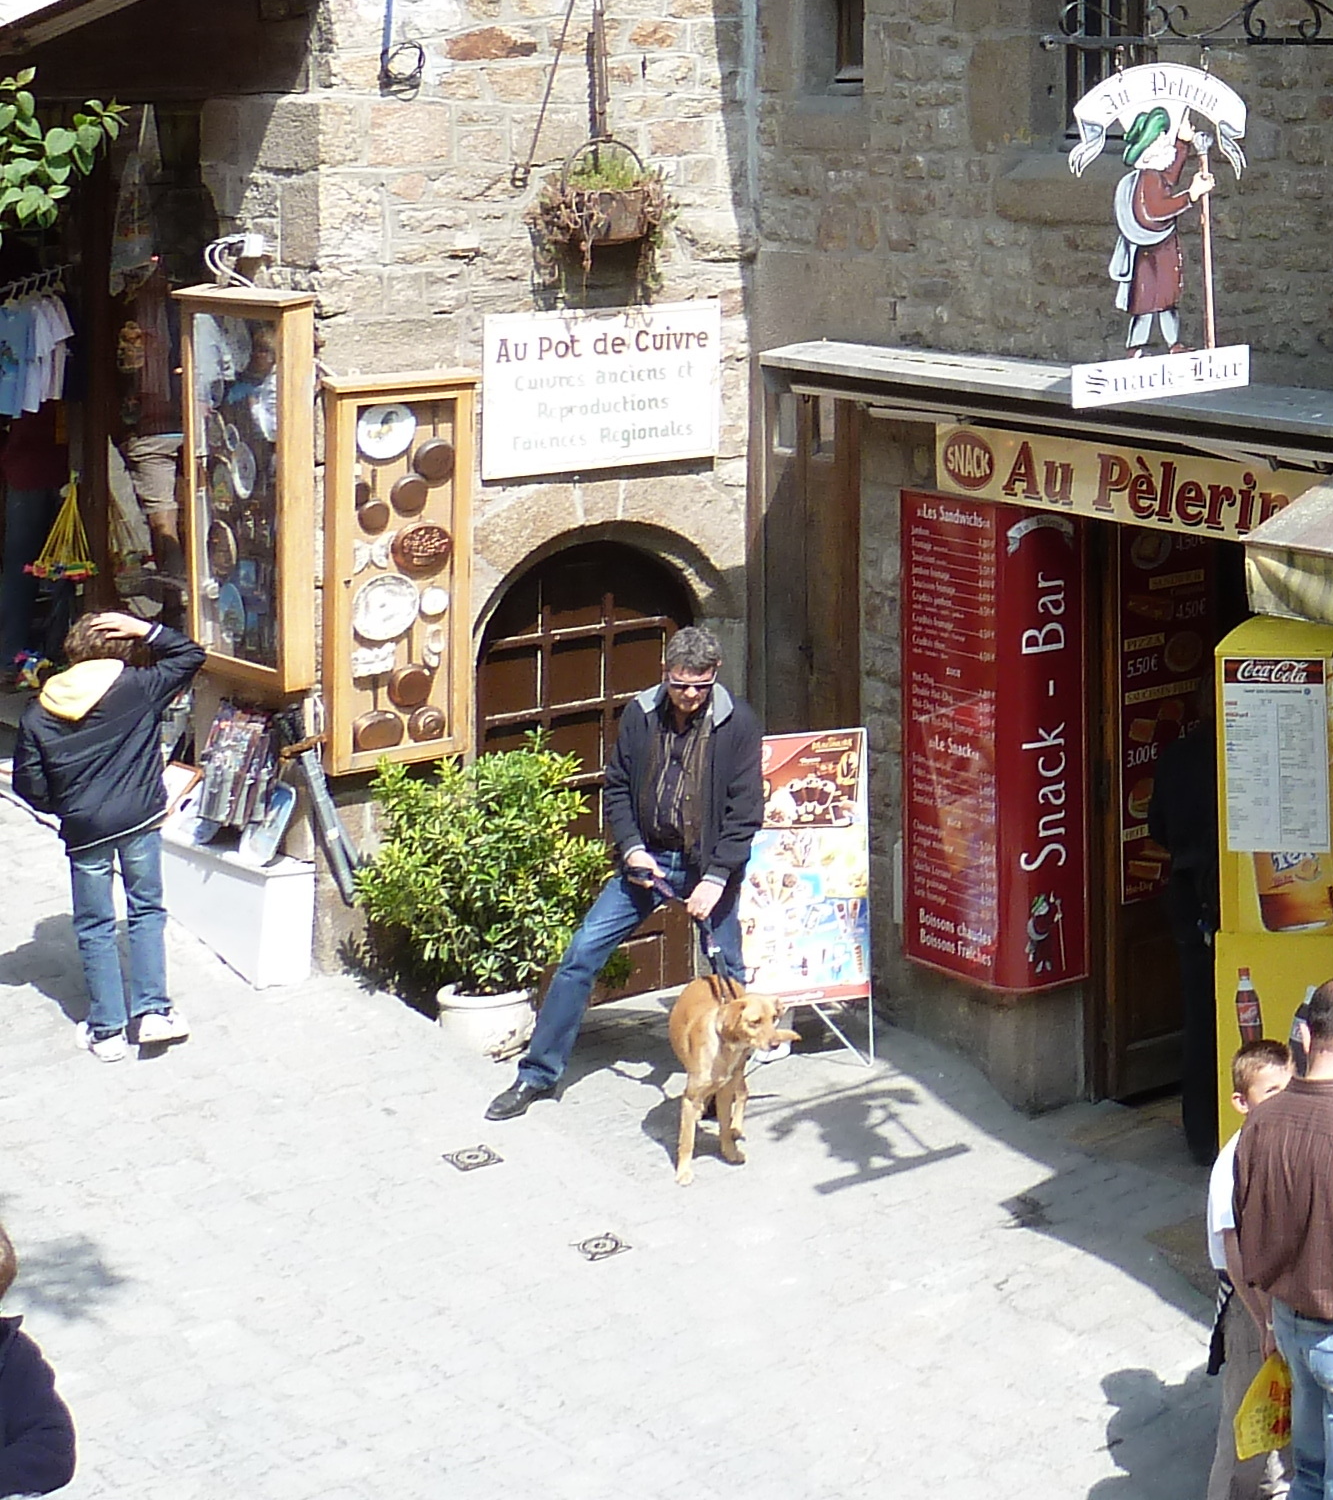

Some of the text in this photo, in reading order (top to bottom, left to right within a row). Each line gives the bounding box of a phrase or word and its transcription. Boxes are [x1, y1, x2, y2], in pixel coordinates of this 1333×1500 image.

[1103, 88, 1131, 115] Au
[496, 326, 710, 363] Au Pot de Cuivre
[596, 364, 667, 385] anciens
[678, 361, 694, 378] et
[537, 395, 669, 422] Reproductions
[946, 442, 992, 479] SNACK
[1001, 440, 1075, 507] Au
[1021, 571, 1066, 655] Bar
[1020, 722, 1067, 872] Snack
[919, 907, 956, 934] Boissons
[920, 927, 956, 955] Boissons
